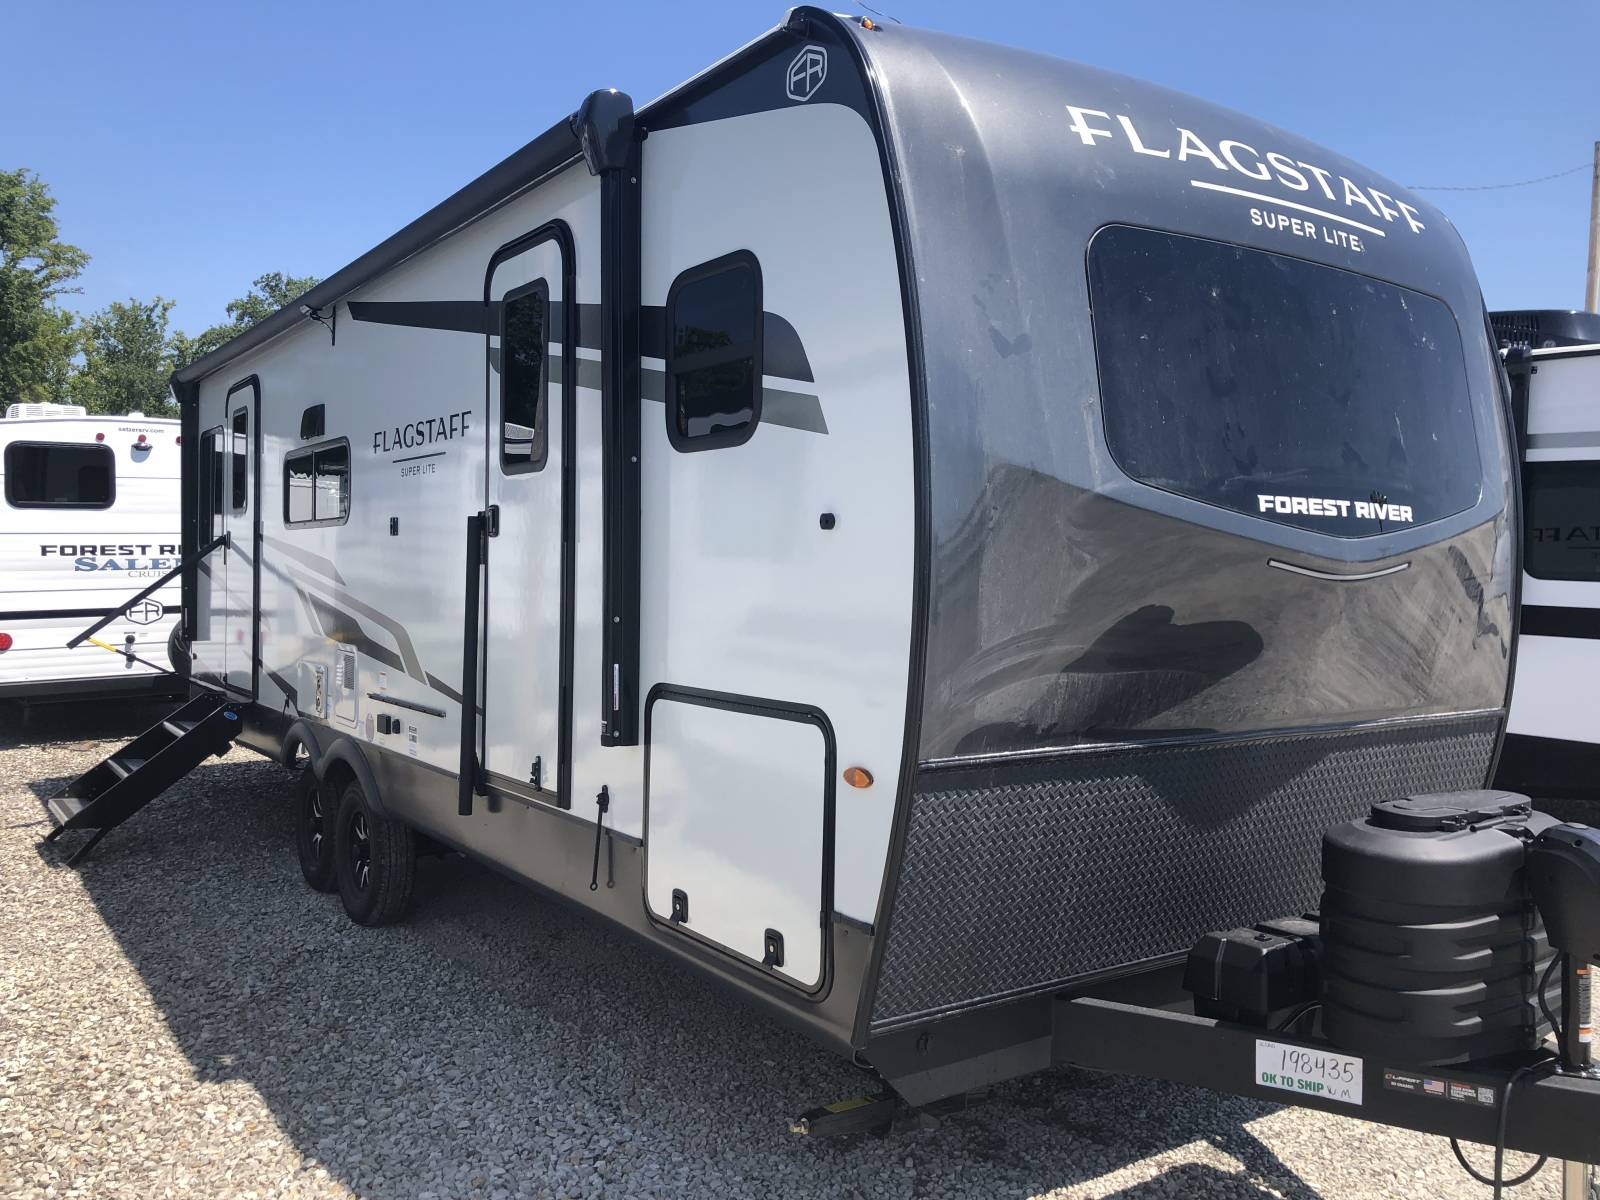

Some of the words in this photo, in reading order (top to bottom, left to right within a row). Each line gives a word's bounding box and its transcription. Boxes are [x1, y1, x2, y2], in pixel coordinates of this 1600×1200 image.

[1065, 105, 1425, 234] FLAGSTAFF
[1249, 208, 1317, 240] SUPER
[1323, 226, 1362, 252] LITE
[373, 410, 472, 454] FLAGSTAFF
[400, 466, 421, 478] SUPER
[422, 463, 436, 475] LITE
[1257, 494, 1351, 518] FOREST
[1354, 501, 1414, 522] RIVER
[40, 545, 152, 556] FOREST
[1281, 1049, 1355, 1083] 198435
[1261, 1071, 1278, 1085] OK
[1280, 1075, 1294, 1087] TO
[1297, 1079, 1325, 1093] SHIP
